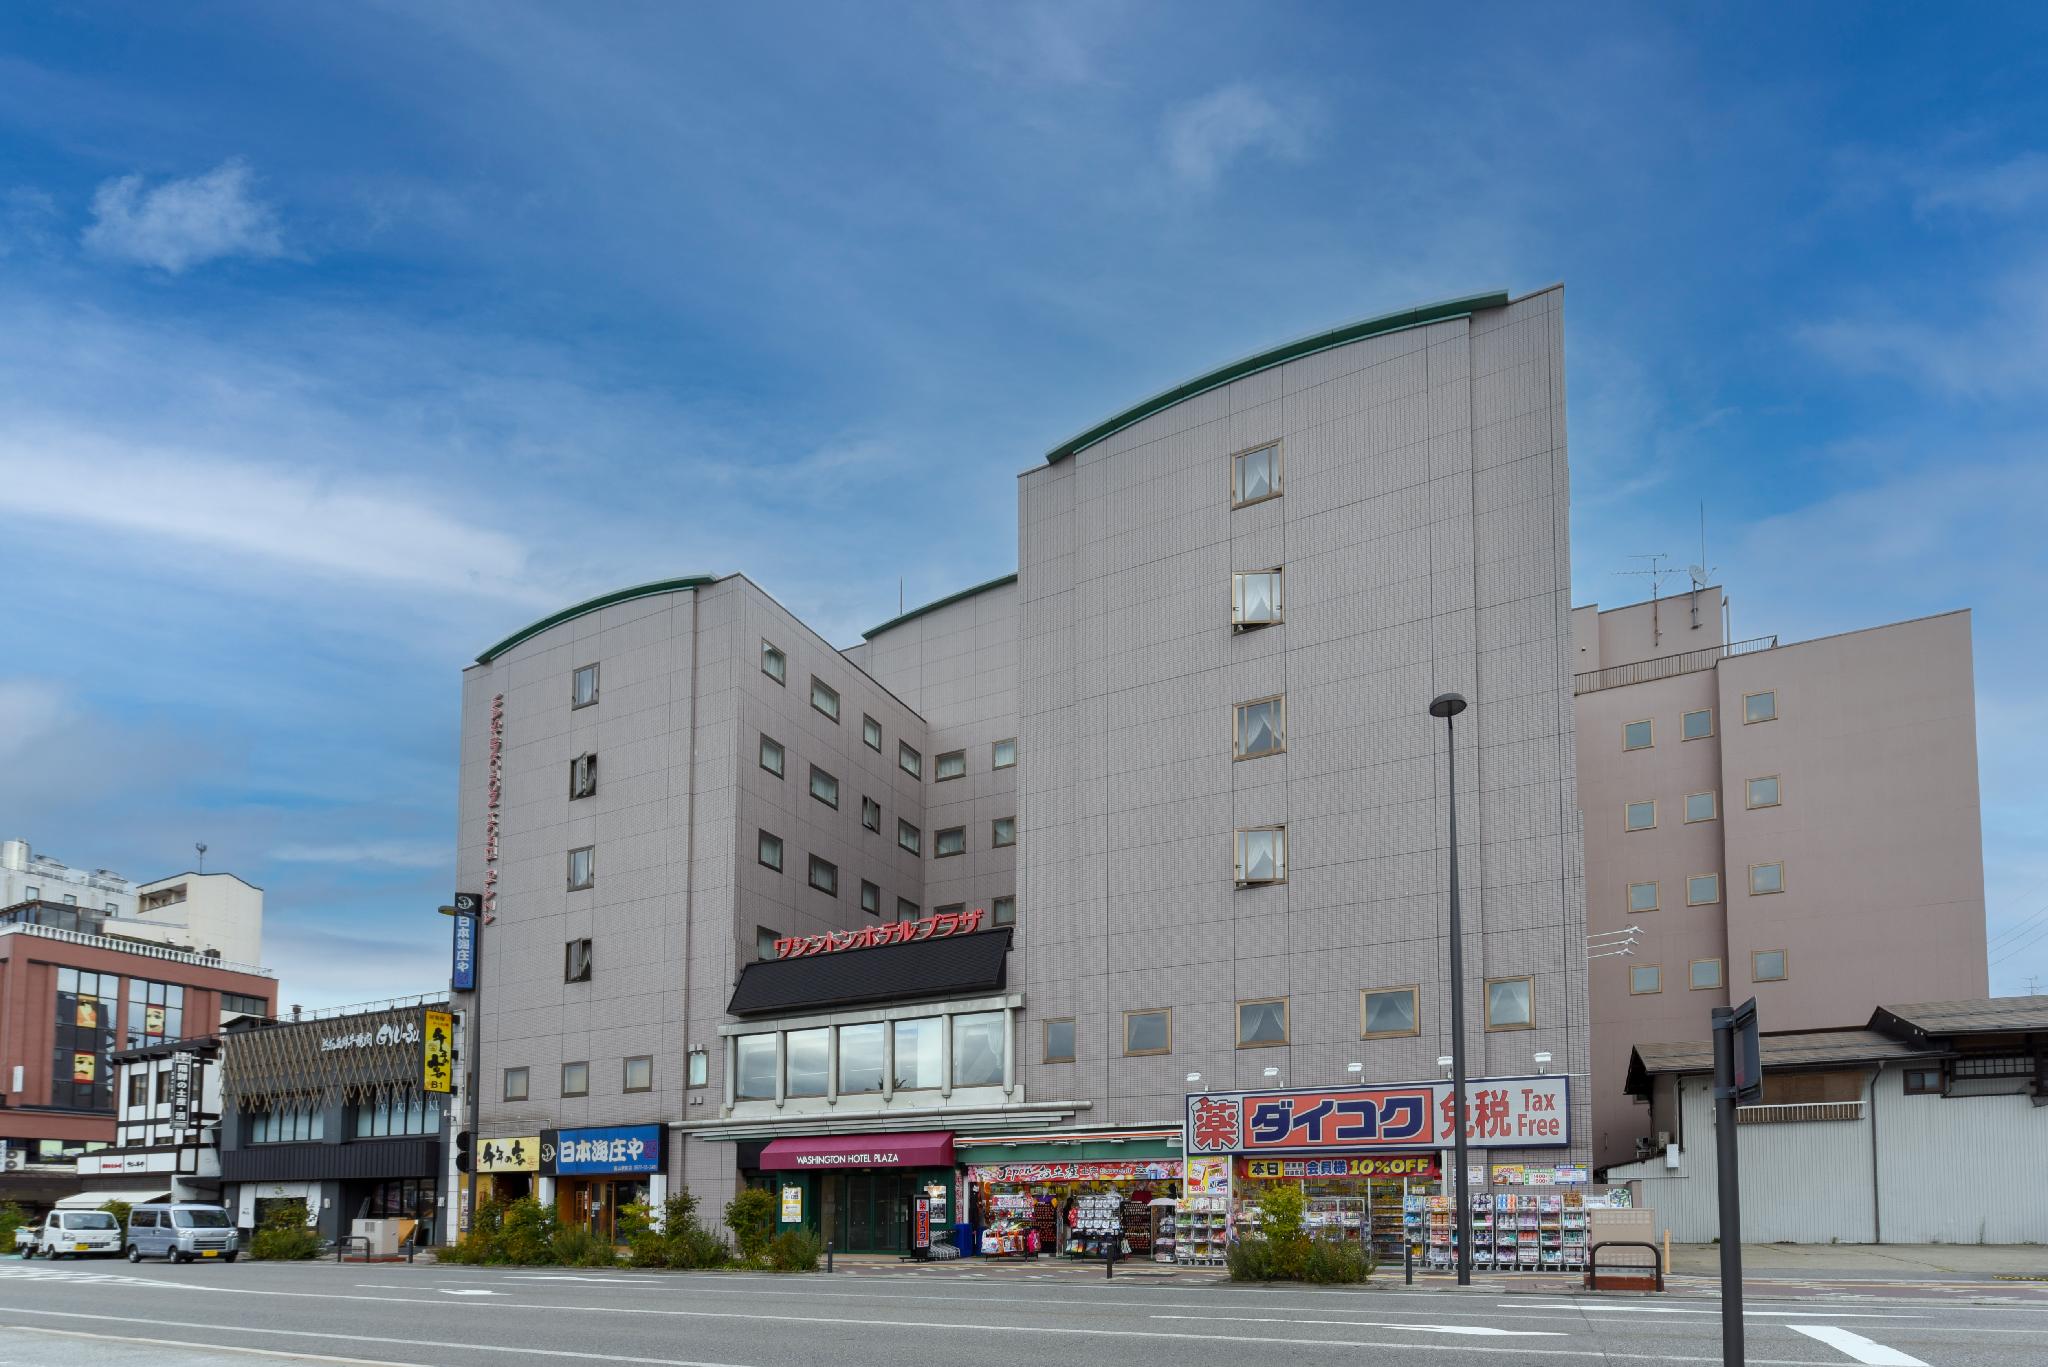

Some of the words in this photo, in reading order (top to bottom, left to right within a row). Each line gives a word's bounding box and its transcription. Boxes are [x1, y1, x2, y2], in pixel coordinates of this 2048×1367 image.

[774, 908, 984, 960] ワシントンホテルプラザ
[1521, 1089, 1555, 1111] Tax
[1191, 1097, 1239, 1151] 薬
[1251, 1095, 1425, 1143] ダイコク
[1440, 1090, 1511, 1139] 免税
[1518, 1113, 1560, 1136] Free
[561, 1138, 644, 1162] 日本海庄や
[797, 1155, 845, 1165] WASHINGTON
[848, 1154, 871, 1163] HOTEL
[874, 1153, 899, 1163] PLAZA
[1252, 1162, 1279, 1176] 本日
[1306, 1160, 1347, 1176] 会員様
[1349, 1158, 1429, 1175] 10%OFF
